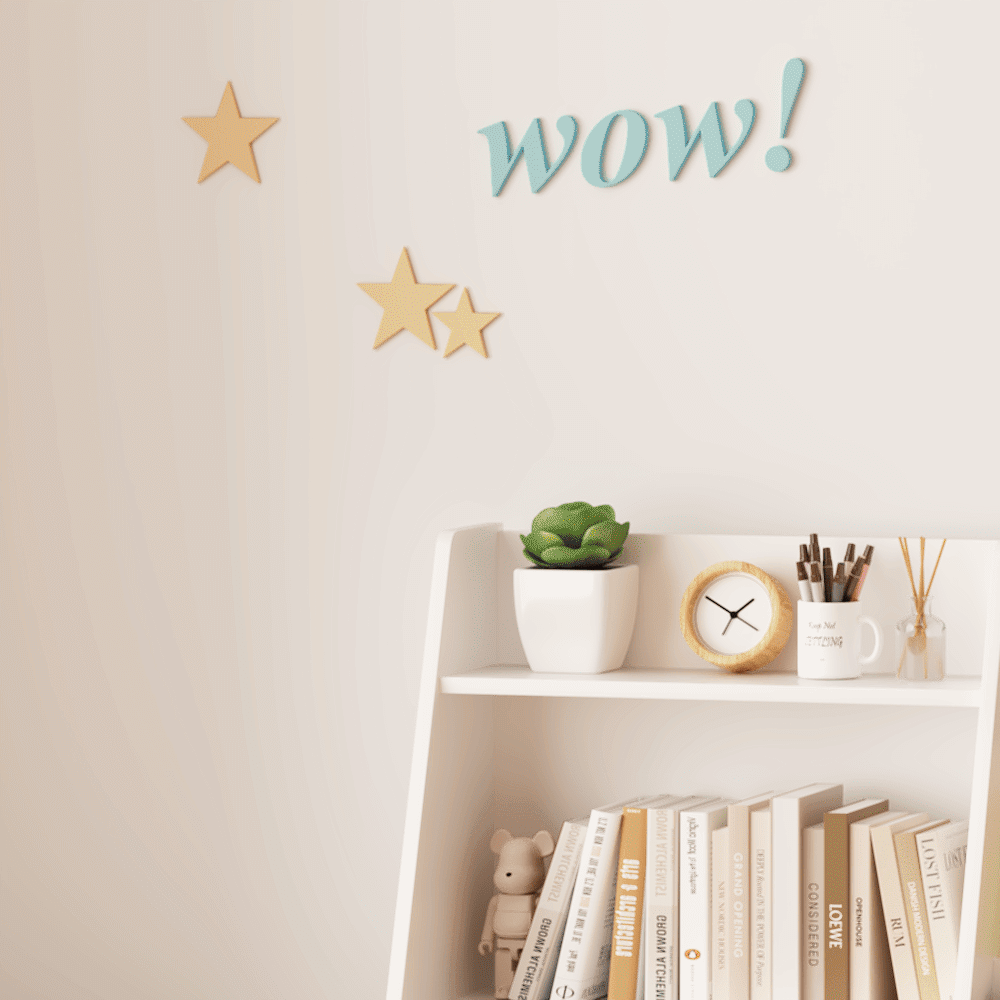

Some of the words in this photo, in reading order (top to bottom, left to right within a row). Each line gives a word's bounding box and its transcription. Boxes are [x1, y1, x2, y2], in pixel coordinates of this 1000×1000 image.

[477, 57, 806, 197] wow!
[733, 852, 744, 897] GRAND
[921, 838, 939, 881] LOST
[808, 882, 819, 967] CONSIDERED
[855, 897, 863, 947] OPENHOUSE
[928, 882, 946, 921] FISH
[733, 901, 744, 958] OPENING
[828, 903, 843, 949] LOEWE
